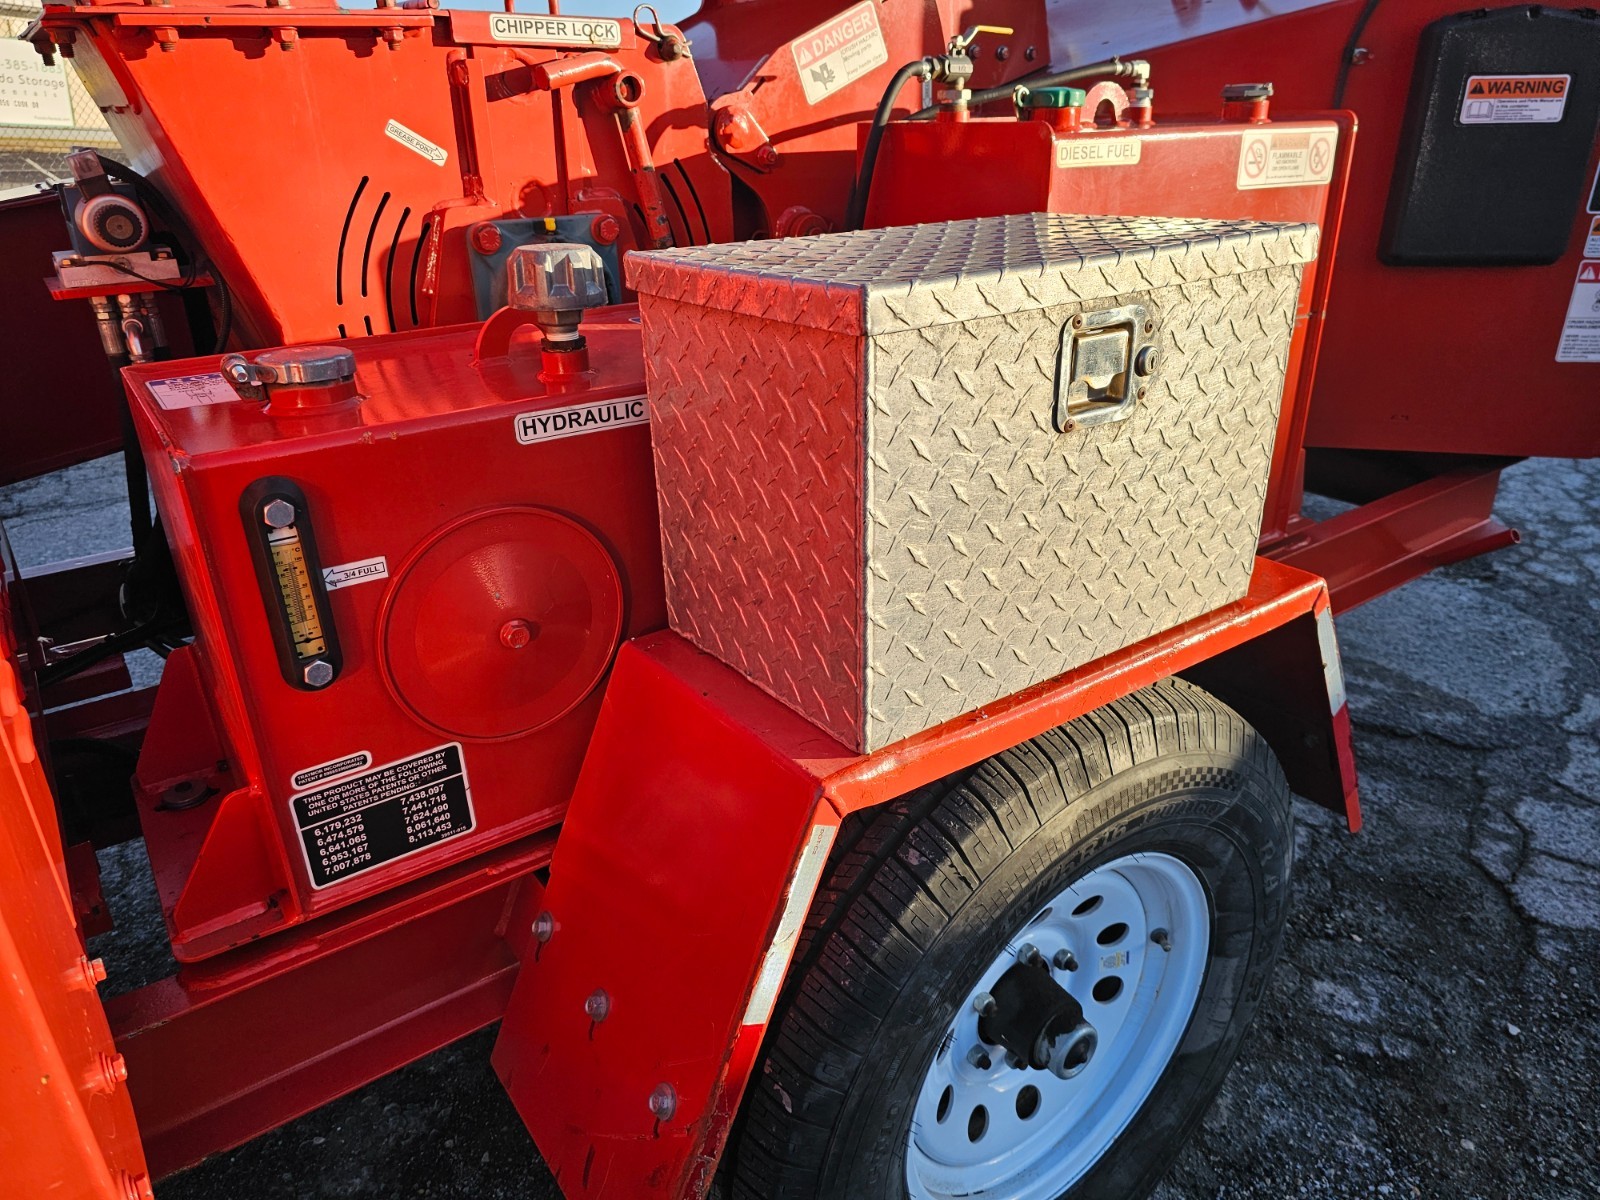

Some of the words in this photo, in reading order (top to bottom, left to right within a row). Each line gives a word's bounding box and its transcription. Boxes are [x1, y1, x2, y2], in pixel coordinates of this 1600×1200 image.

[495, 18, 567, 36] CHIPPER
[572, 22, 616, 38] LOCK
[811, 11, 874, 58] DANGER
[18, 74, 65, 90] Storage
[1487, 80, 1565, 94] WARNING
[389, 126, 415, 144] GREASE
[415, 141, 434, 155] POINT
[1060, 145, 1104, 161] DIESEL
[1107, 144, 1137, 159] FUEL
[1272, 151, 1303, 160] FLAMMABLE
[522, 401, 644, 436] HYDRAULIC
[343, 570, 356, 579] 3/4
[358, 565, 380, 575] FULL
[297, 768, 323, 780] TRAYMOR
[324, 755, 364, 771] INCORPORATED
[303, 793, 322, 804] THIS
[323, 780, 364, 798] PRODUCT
[365, 773, 382, 784] MAY
[383, 769, 395, 778] BE
[396, 756, 434, 773] COVERED
[435, 751, 446, 760] BY
[298, 775, 319, 785] PATENT
[308, 799, 327, 810] ONE
[328, 794, 341, 803] OR
[342, 786, 367, 799] MORE
[367, 781, 379, 790] OF
[380, 775, 397, 786] THE
[397, 758, 445, 780] FOLLOWING
[308, 802, 338, 817] UNITED
[339, 791, 370, 807] STATES
[371, 778, 407, 795] PATENTS
[407, 774, 420, 783] OR
[421, 763, 448, 778] OTHER
[343, 794, 379, 812] PATENTS
[380, 782, 418, 799] PENDING:
[400, 783, 445, 806] 7,438,097
[314, 814, 363, 836] 6,179,232
[404, 803, 449, 825] 7,624,490
[406, 812, 451, 834] 8,061,640
[317, 824, 365, 846] 6,474,579
[408, 821, 452, 843] 8,113,453
[812, 828, 825, 855] DOT-C2
[320, 833, 367, 856] 6,641,065
[322, 842, 369, 866] 6,953,167
